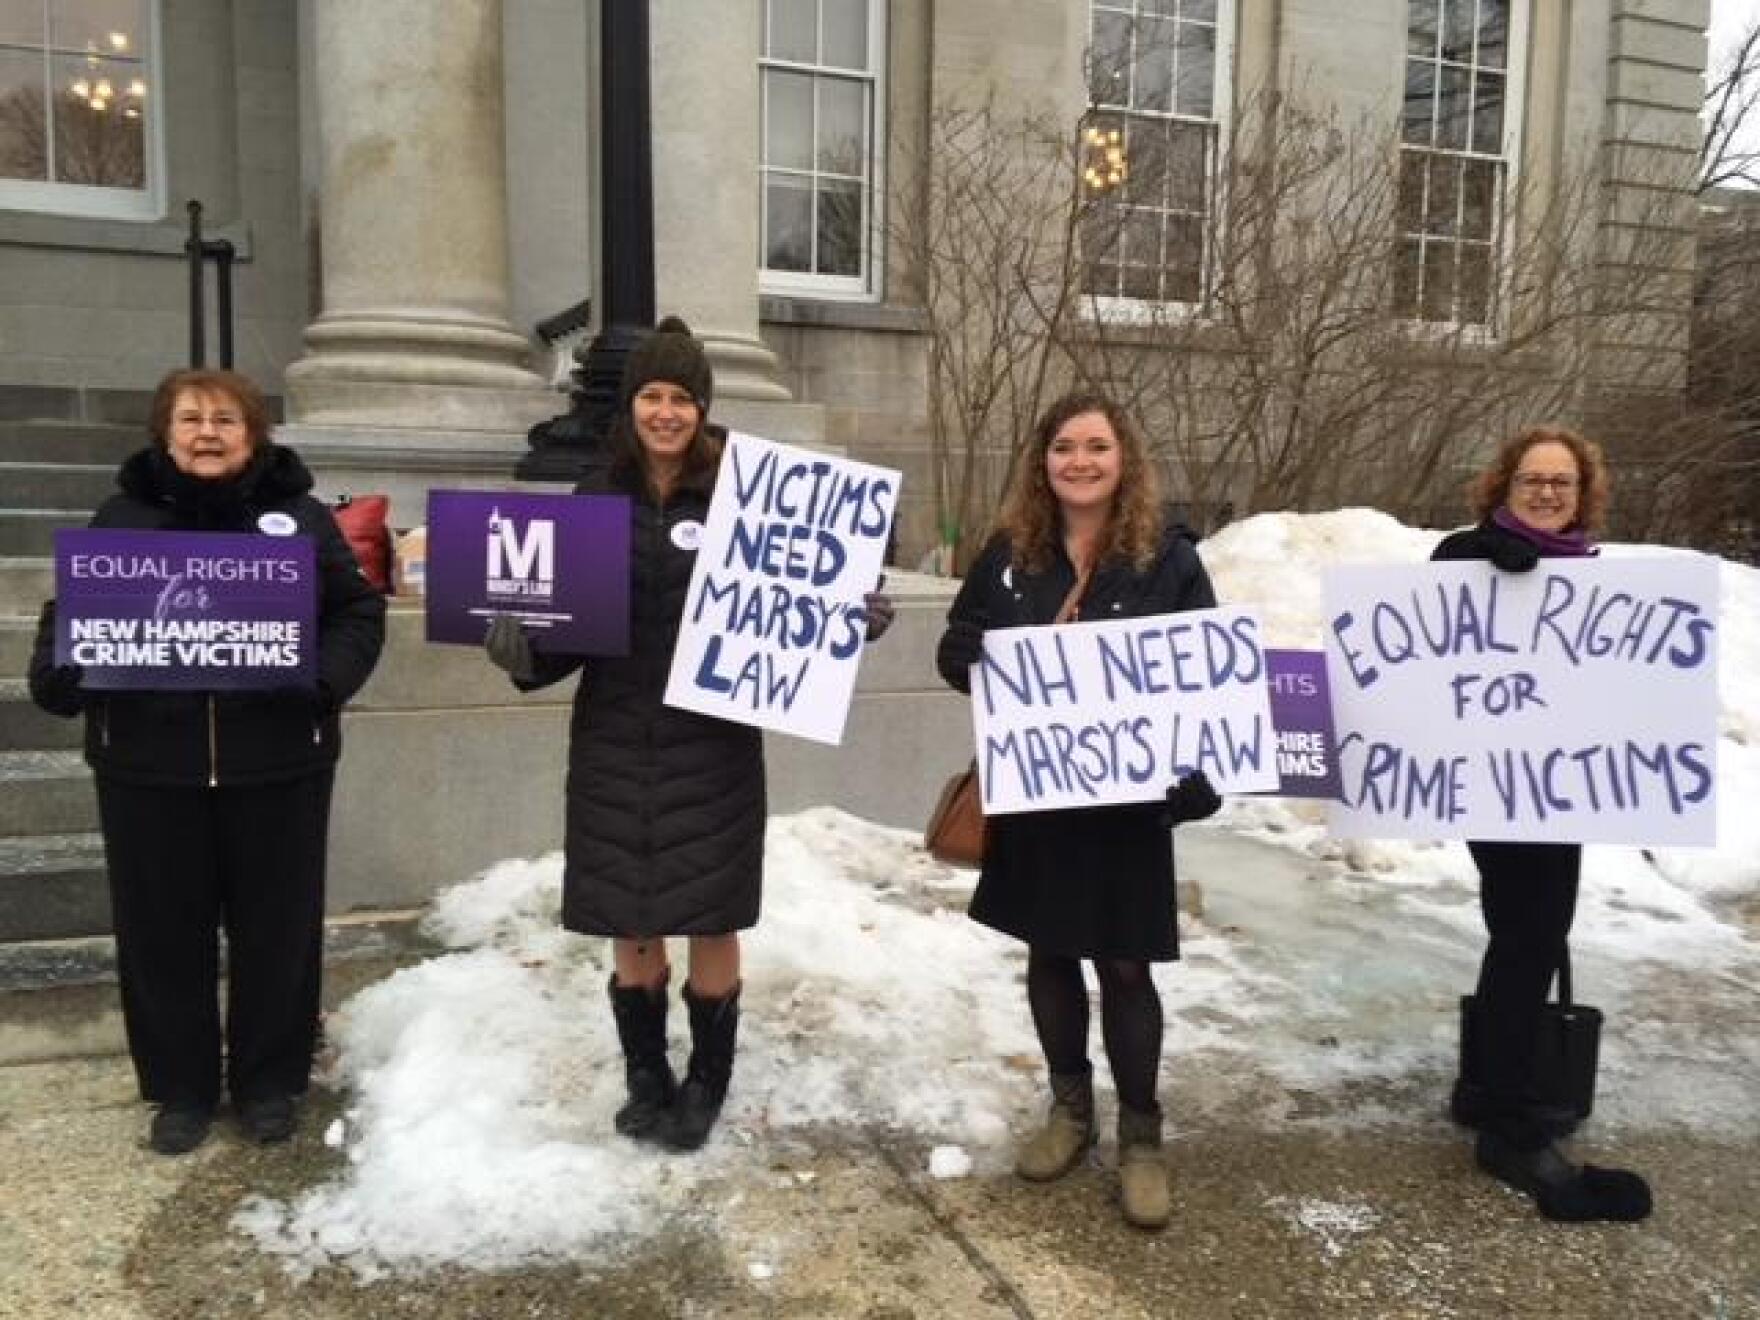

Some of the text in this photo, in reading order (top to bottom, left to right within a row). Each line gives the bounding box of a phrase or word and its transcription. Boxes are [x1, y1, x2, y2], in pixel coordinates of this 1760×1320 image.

[732, 442, 892, 537] VICTIMS
[70, 555, 299, 583] EQUAL RIGHTS
[724, 517, 848, 587] NEED
[154, 572, 212, 619] for
[70, 619, 300, 642] NEW HAMPSHIRE
[70, 642, 300, 667] CRIME VICTIMS
[1333, 574, 1714, 689] EQUAL RIGHTS
[694, 634, 810, 714] LAW
[981, 616, 1262, 716] NH NEEDS
[1451, 671, 1549, 720] FOR
[1171, 712, 1263, 781] LAW
[1337, 732, 1712, 823] CRIME VICTIMS
